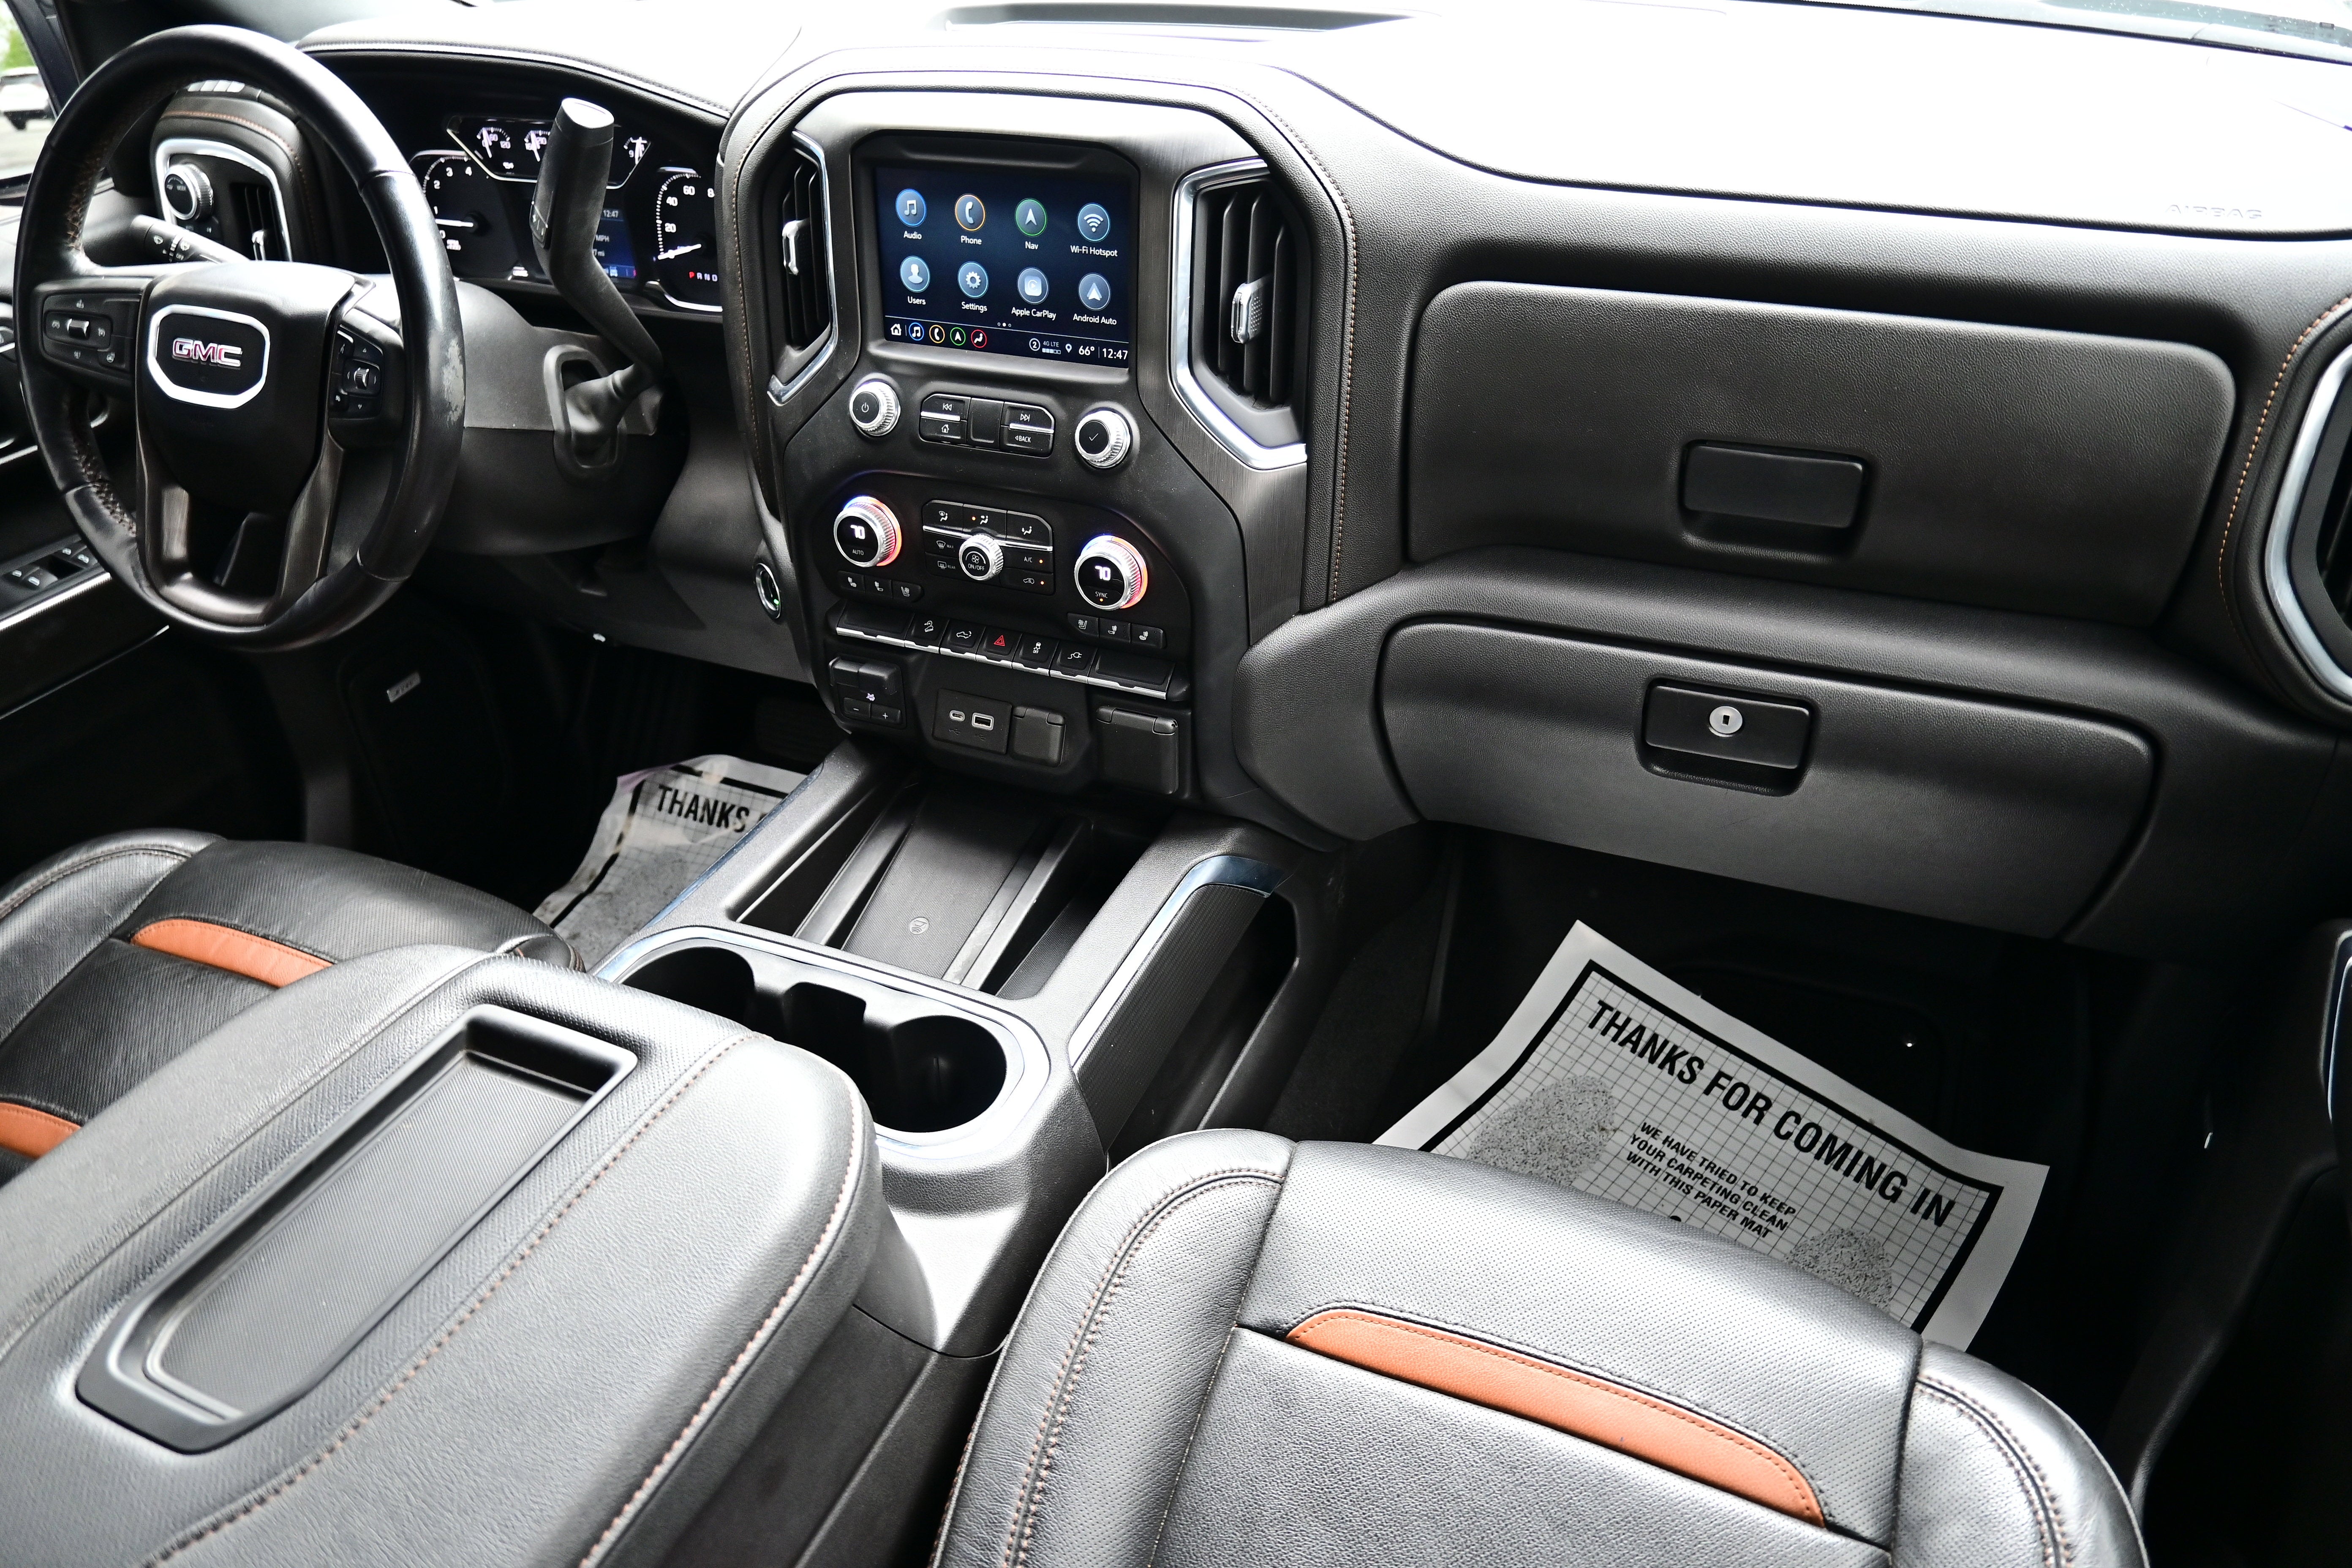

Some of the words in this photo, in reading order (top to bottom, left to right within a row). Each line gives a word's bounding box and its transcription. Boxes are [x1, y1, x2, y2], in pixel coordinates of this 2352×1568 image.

[629, 150, 634, 158] 9
[446, 167, 453, 177] 3
[465, 166, 472, 176] 4
[433, 180, 441, 189] 2
[683, 185, 695, 196] 60
[666, 196, 678, 207] 40
[603, 210, 619, 218] 12:47
[665, 223, 676, 233] 20
[596, 234, 610, 242] MPH
[904, 231, 922, 240] Audio
[961, 235, 982, 245] Phone
[1025, 241, 1038, 250] Nav
[1070, 245, 1088, 254] Wi-Fi
[1090, 247, 1118, 258] Hotspot
[907, 296, 926, 305] Users
[961, 302, 988, 313] Settings
[1011, 307, 1030, 317] Apple
[1031, 309, 1056, 321] CarPlay
[1073, 313, 1099, 323] Android
[1100, 316, 1117, 325] Auto
[173, 338, 242, 368] GMC
[1078, 345, 1095, 356] 66°
[1102, 348, 1128, 359] 12:47
[850, 524, 866, 539] 70
[1094, 565, 1111, 581] 70
[658, 784, 750, 833] THANKS
[1588, 1000, 1704, 1084] THANKS
[1703, 1070, 1773, 1125] FOR
[1774, 1111, 1908, 1203] COMING
[1910, 1188, 1955, 1228] IN
[1641, 1122, 1663, 1140] WE
[1662, 1135, 1698, 1162] HAVE
[1699, 1157, 1737, 1184] TRIED
[1740, 1180, 1759, 1196] TO
[1759, 1192, 1796, 1215] KEEP
[1631, 1134, 1666, 1162] YOUR
[1667, 1158, 1741, 1205] CARPETING
[1742, 1201, 1788, 1230] CLEAN
[1627, 1152, 1661, 1176] WITH
[1663, 1172, 1693, 1195] THIS
[1694, 1191, 1739, 1221] PAPER
[1740, 1216, 1772, 1238] MAT
